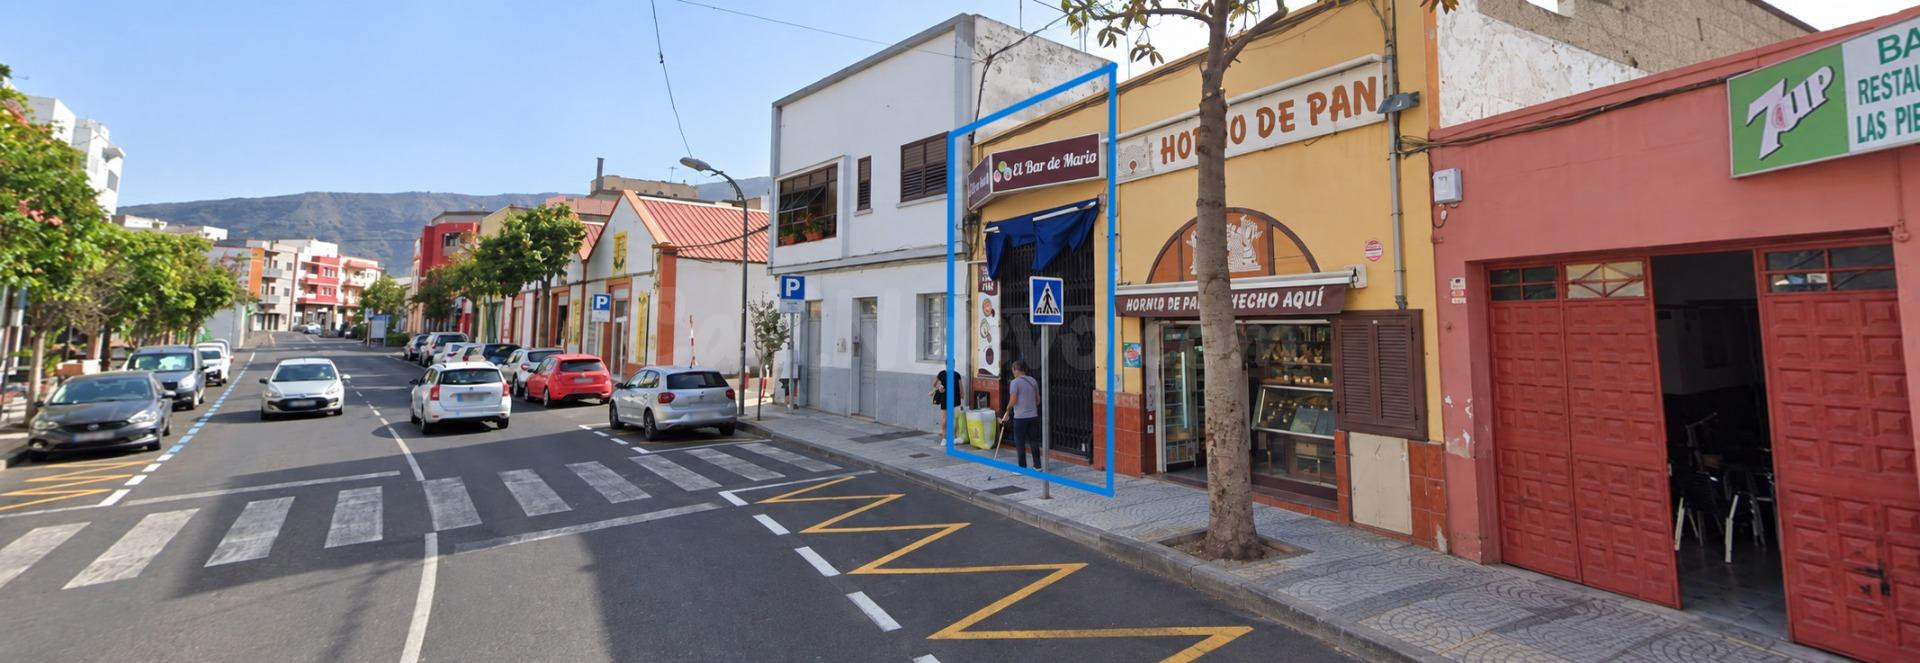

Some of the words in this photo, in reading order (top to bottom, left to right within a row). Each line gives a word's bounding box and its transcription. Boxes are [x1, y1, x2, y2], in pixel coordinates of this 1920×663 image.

[1160, 114, 1247, 165] HOO
[1256, 99, 1296, 139] DE
[1306, 76, 1378, 126] PAN
[1857, 110, 1887, 144] LAS
[1012, 162, 1024, 177] El
[1025, 159, 1046, 174] Bar
[1047, 156, 1061, 171] de
[1063, 150, 1097, 168] Mario
[785, 278, 800, 297] P
[1167, 296, 1181, 311] DE
[1182, 295, 1201, 311] PA
[1282, 286, 1325, 309] AQUÍ
[596, 295, 608, 310] P
